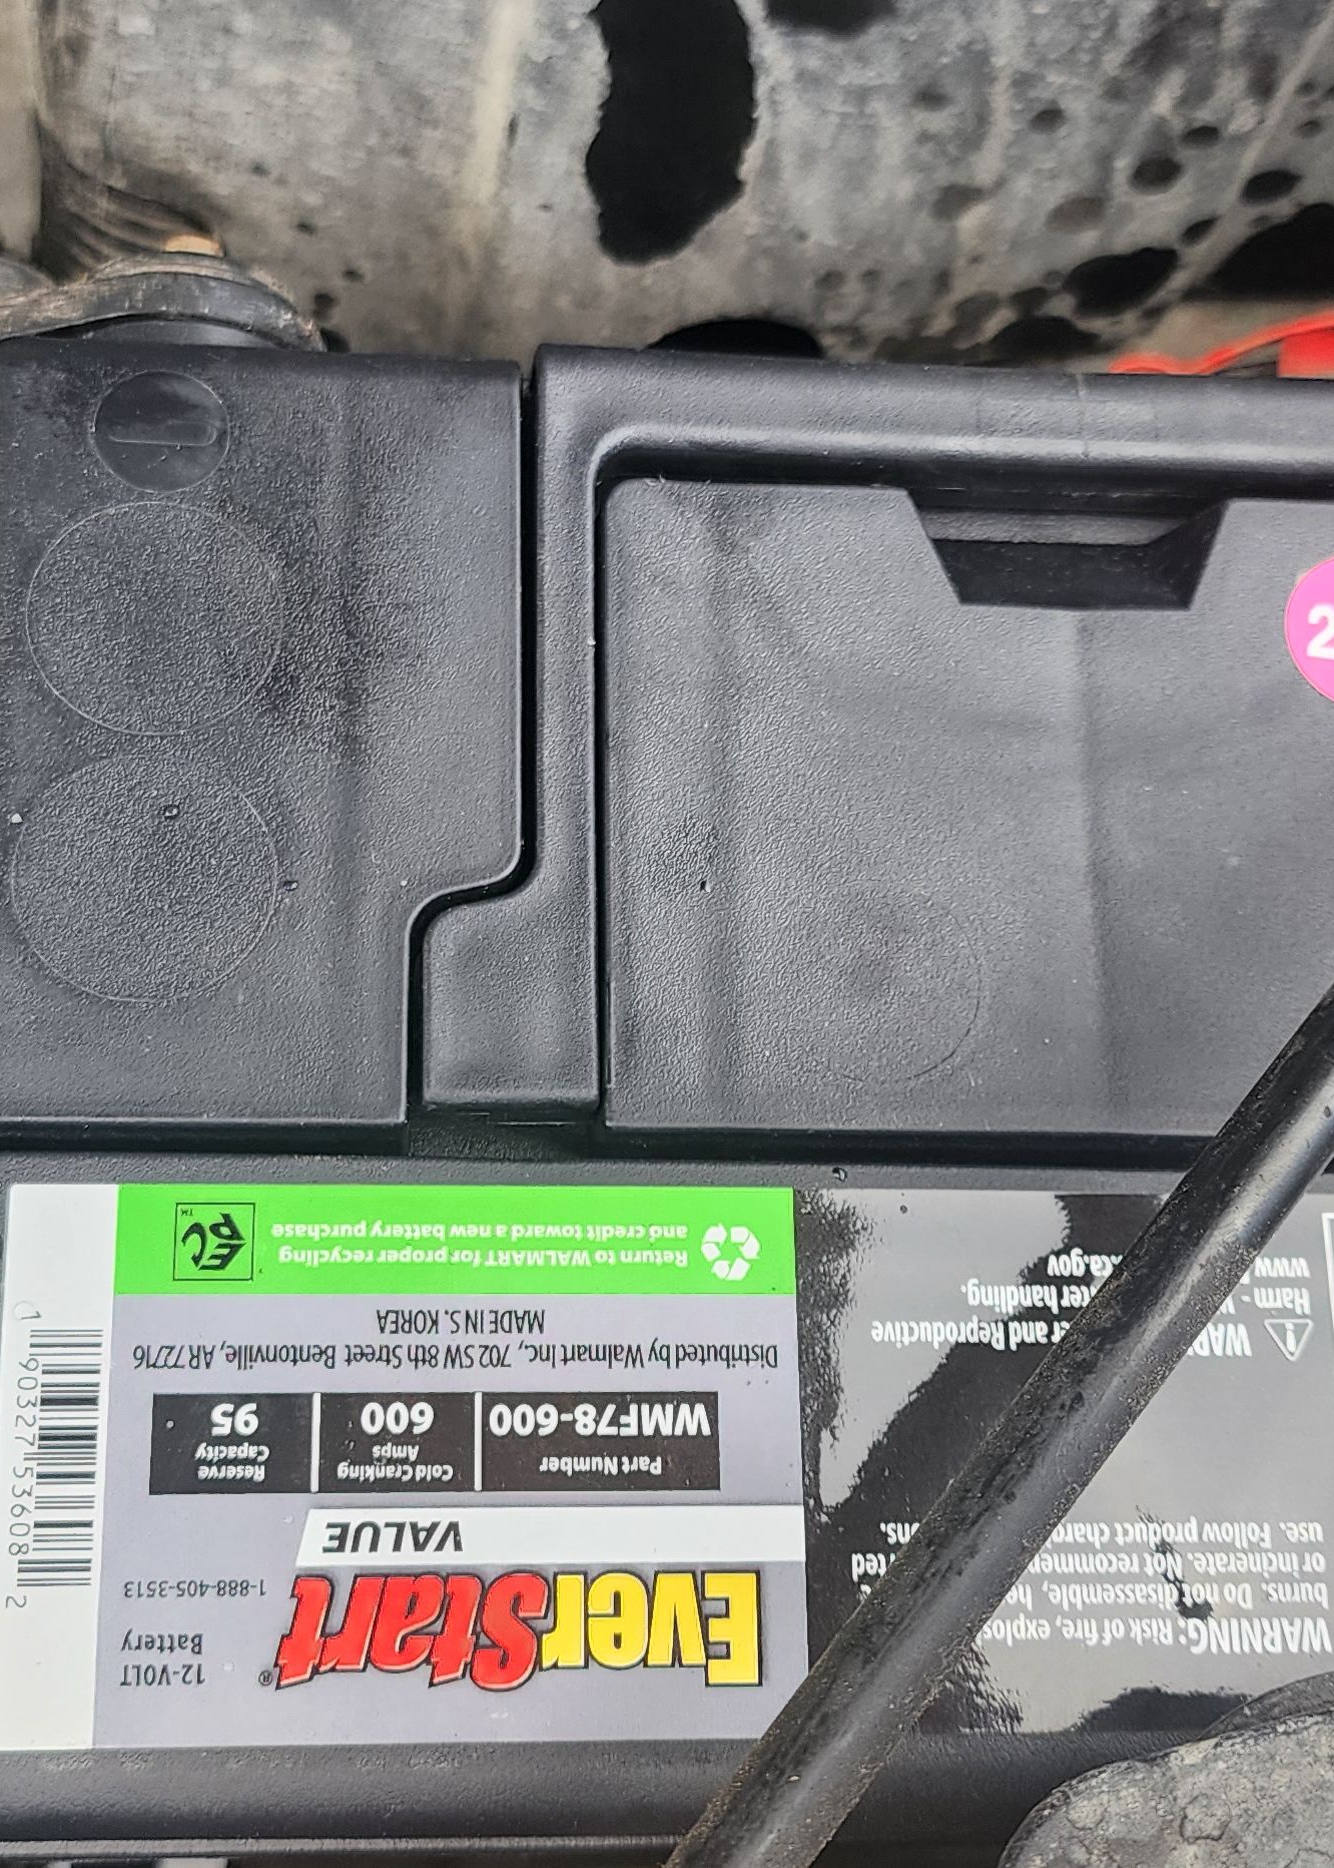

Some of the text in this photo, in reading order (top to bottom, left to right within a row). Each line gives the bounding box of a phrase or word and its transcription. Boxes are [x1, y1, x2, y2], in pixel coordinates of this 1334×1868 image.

[271, 1220, 689, 1242] and credit toward a new battery purchase
[278, 1245, 689, 1267] Return to WALMART for proper recycling
[960, 1278, 1058, 1314] handling.
[1253, 1287, 1311, 1315] Harm
[376, 1309, 546, 1335] MADE IN S. KOREA
[871, 1316, 1005, 1350] Reproductive
[1008, 1320, 1048, 1351] and
[132, 1337, 778, 1370] Distributed by Walmart Inc., 702 SW 8th Street Bentonville, AR 72716
[1186, 1323, 1252, 1357] WAR
[15, 1357, 39, 1447] 90327
[210, 1402, 259, 1436] 95
[360, 1401, 435, 1435] 600
[488, 1402, 711, 1437] WMF78-600
[194, 1442, 270, 1463] Capacity
[372, 1442, 419, 1461] Amps
[197, 1464, 265, 1482] Reserve
[336, 1462, 454, 1482] Cold Cranking
[539, 1456, 662, 1477] Part Number
[8, 1466, 34, 1557] 53608
[321, 1520, 463, 1554] VALUE
[1046, 1522, 1110, 1550] charg
[1114, 1516, 1199, 1551] product
[1202, 1521, 1272, 1550] Follow
[1279, 1521, 1324, 1543] use.
[1143, 1552, 1183, 1581] Not
[1186, 1551, 1300, 1579] incinerate.
[1302, 1552, 1326, 1574] or
[5, 1595, 27, 1609] 2
[123, 1579, 267, 1598] 1-888-405-3513
[1042, 1580, 1178, 1612] disassemble,
[1182, 1582, 1219, 1608] not
[1223, 1582, 1253, 1610] Do
[1261, 1582, 1329, 1610] burns.
[120, 1629, 203, 1655] Battery
[1055, 1616, 1099, 1646] fire,
[1101, 1618, 1125, 1647] of
[1128, 1618, 1173, 1646] Risk
[1177, 1617, 1332, 1655] WARNING:
[120, 1663, 206, 1686] 12-VOLT
